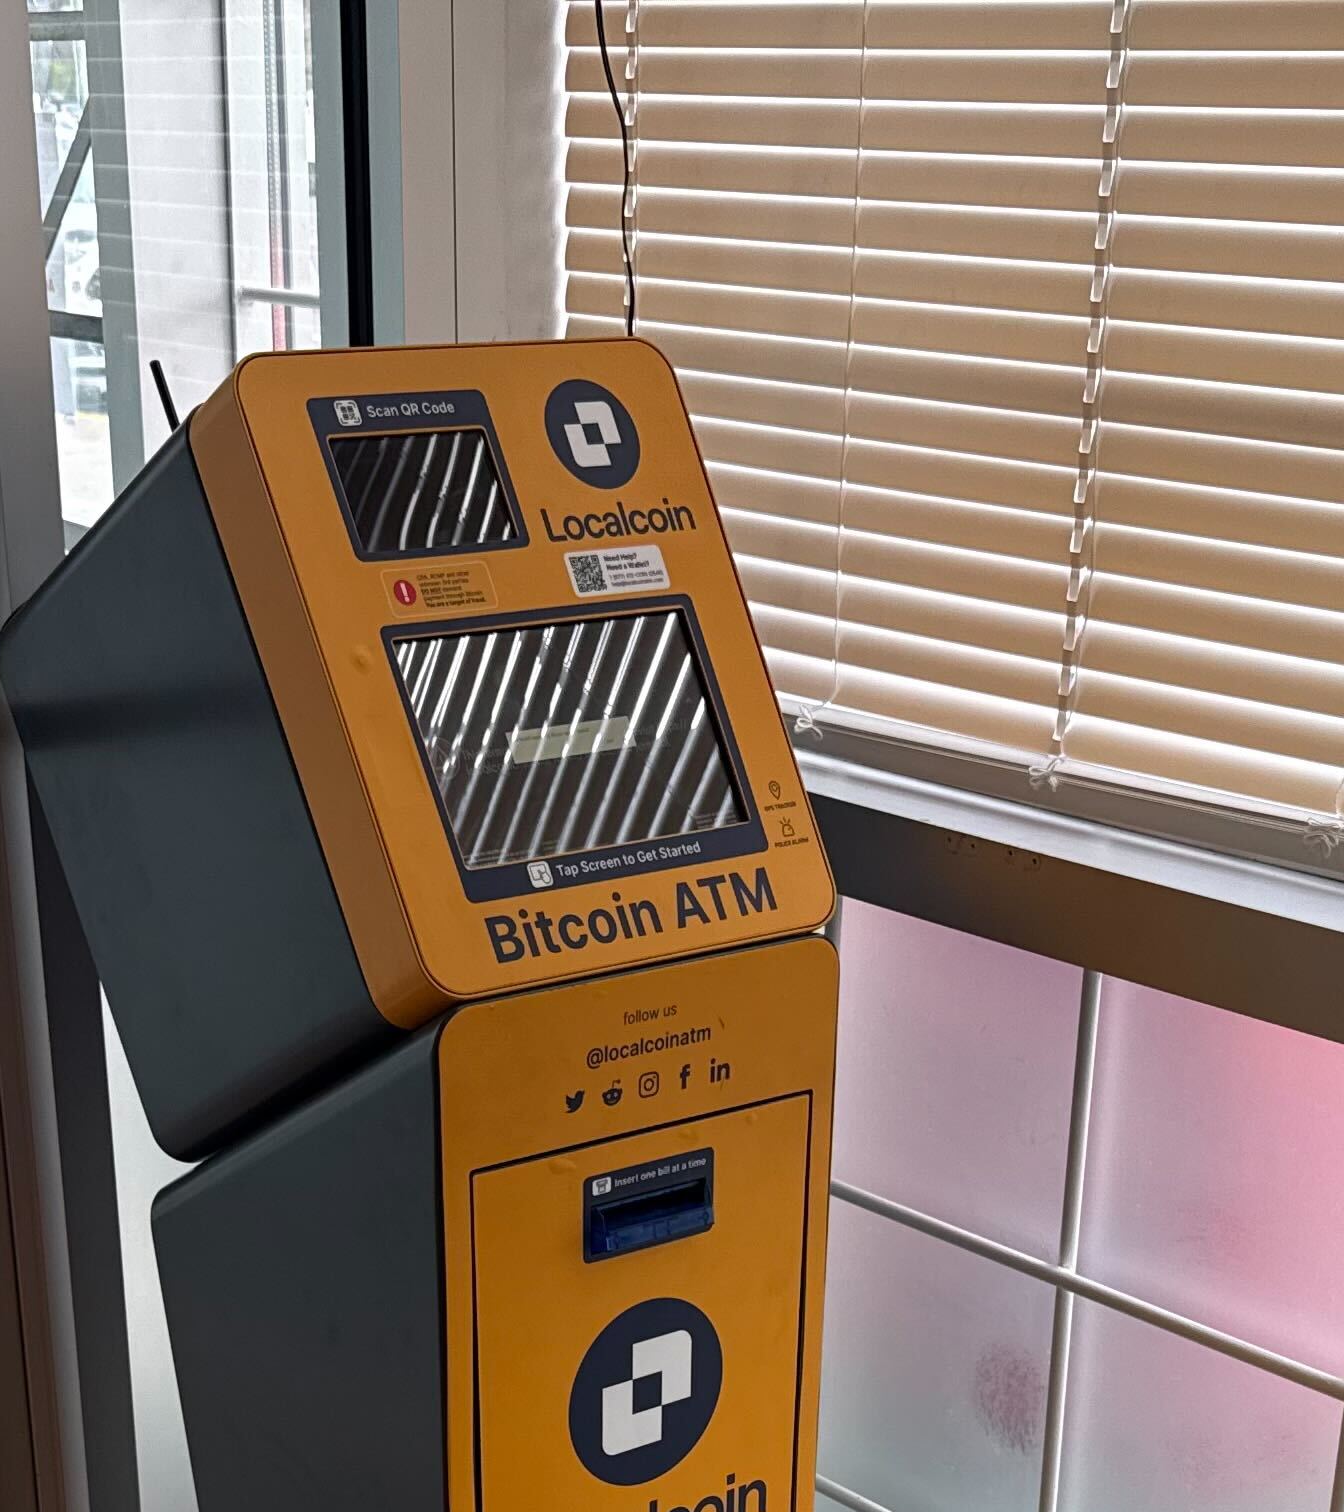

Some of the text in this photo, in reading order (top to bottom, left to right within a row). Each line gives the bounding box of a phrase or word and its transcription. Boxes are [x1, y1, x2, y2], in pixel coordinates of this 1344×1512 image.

[366, 402, 455, 418] Scan QR Code
[540, 497, 696, 544] Localcoin
[556, 841, 702, 878] Tap Screen to Get Started
[485, 867, 779, 965] Bitcoin ATM
[623, 1004, 678, 1026] follow us
[586, 1027, 712, 1070] @localcoinatm
[614, 1157, 707, 1188] Insert one bill at a time
